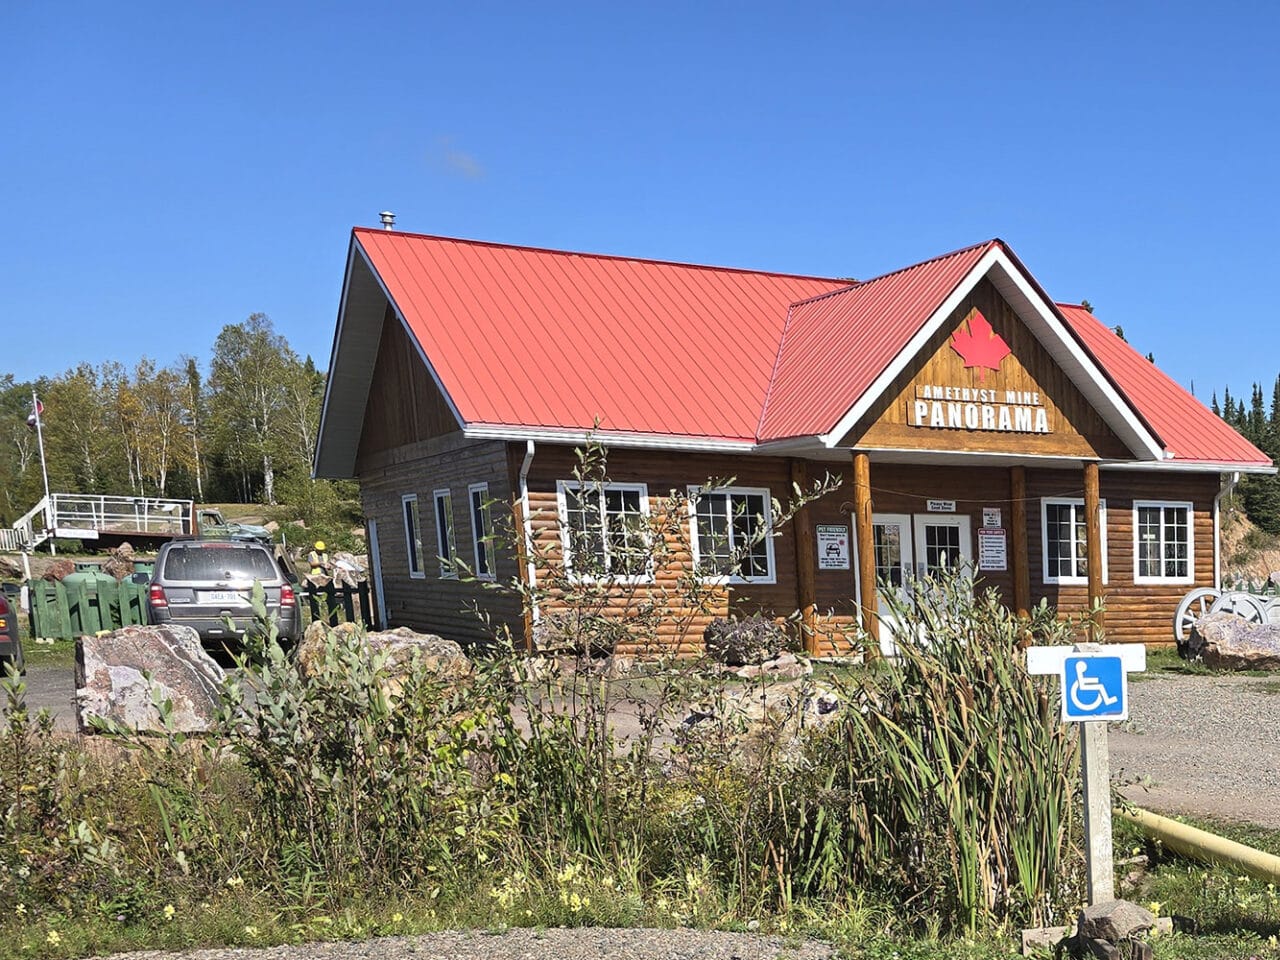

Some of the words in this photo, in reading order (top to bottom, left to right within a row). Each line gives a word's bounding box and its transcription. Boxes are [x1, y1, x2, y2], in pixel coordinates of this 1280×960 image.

[923, 384, 997, 403] AMETHYST
[1005, 390, 1040, 405] MINE
[914, 400, 1050, 433] PANORAMA
